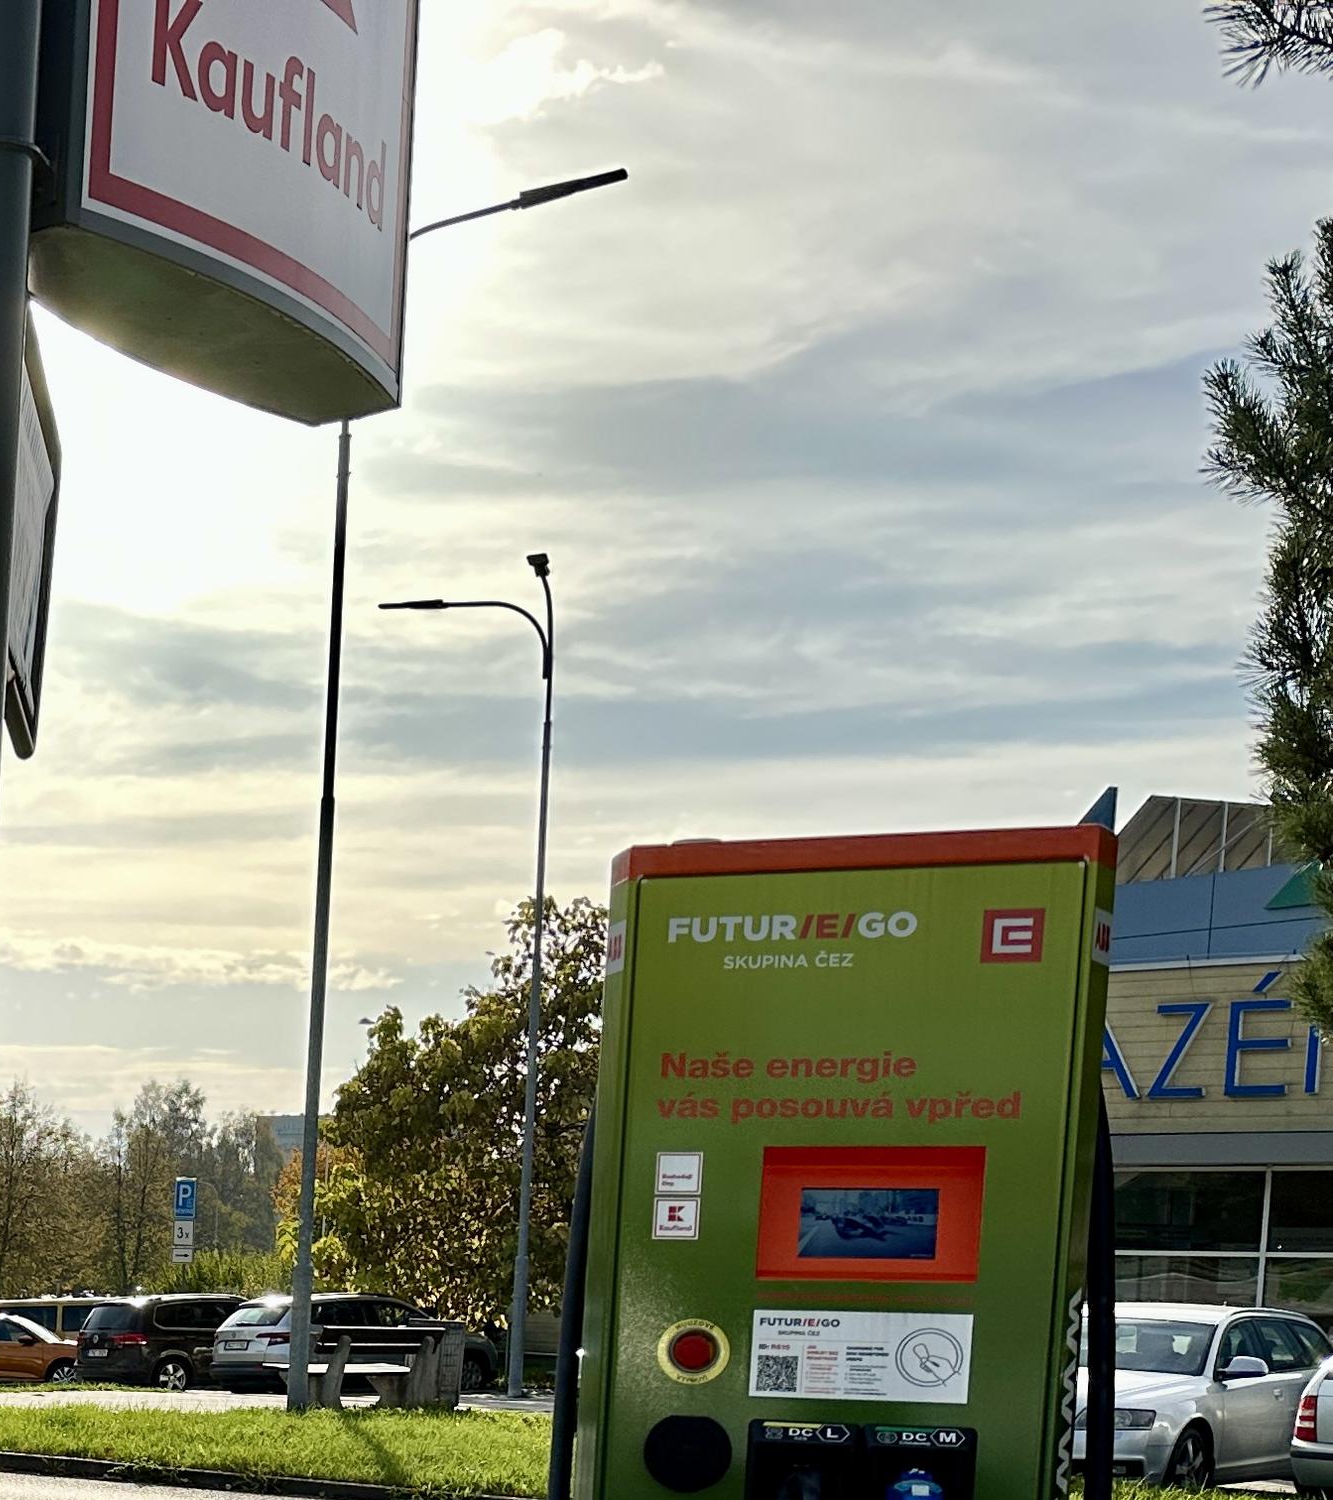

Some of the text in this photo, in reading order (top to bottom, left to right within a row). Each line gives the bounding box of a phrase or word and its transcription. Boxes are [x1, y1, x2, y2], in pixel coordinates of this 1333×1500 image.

[151, 0, 387, 232] Kaufland
[667, 911, 919, 944] FUTUR/E/GO
[722, 951, 855, 970] SKUPINA ČEZ
[659, 1050, 918, 1085] Naše energie
[656, 1091, 1023, 1126] vás posouvá vpřed
[759, 1316, 841, 1328] FUTUR/E/GO
[788, 1427, 839, 1438] DC L
[902, 1432, 928, 1442] DC
[939, 1432, 957, 1443] M
